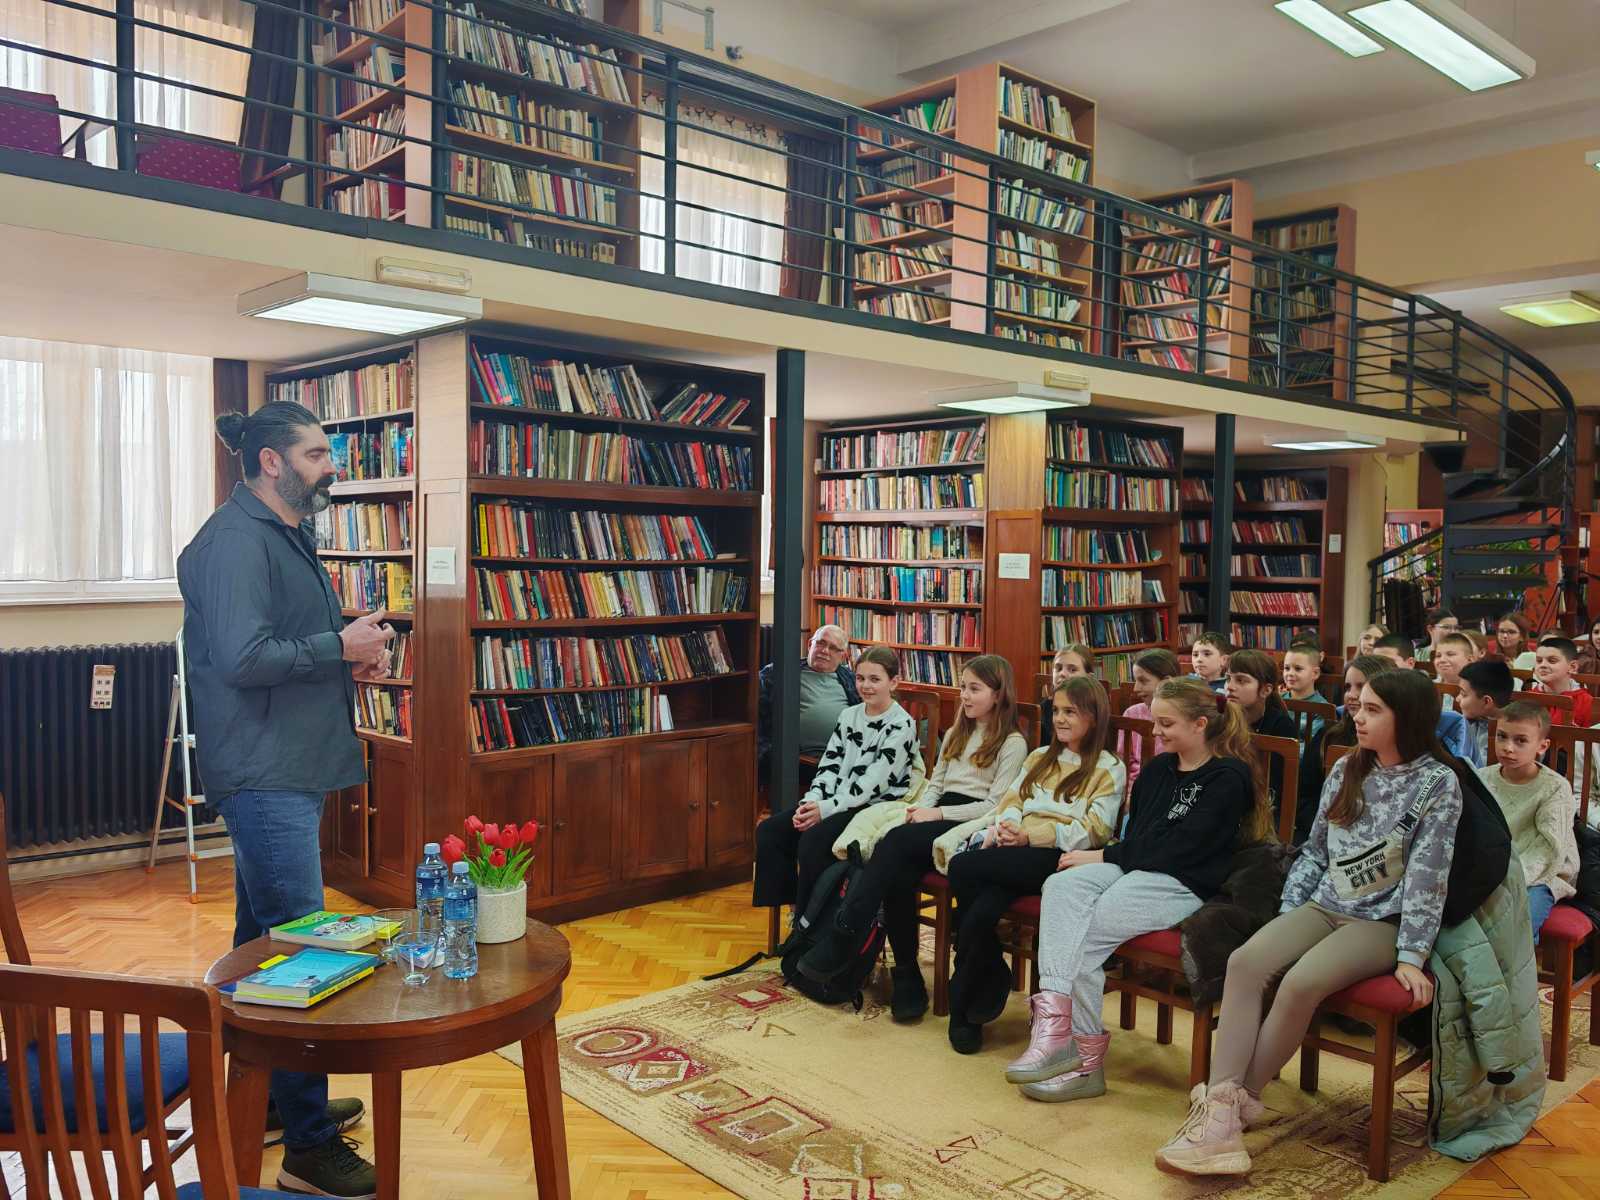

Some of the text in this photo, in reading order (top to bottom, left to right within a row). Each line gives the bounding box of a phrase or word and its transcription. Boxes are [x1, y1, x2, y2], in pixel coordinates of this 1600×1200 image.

[1344, 850, 1386, 877] NEW YORK
[1351, 861, 1389, 888] CITY
